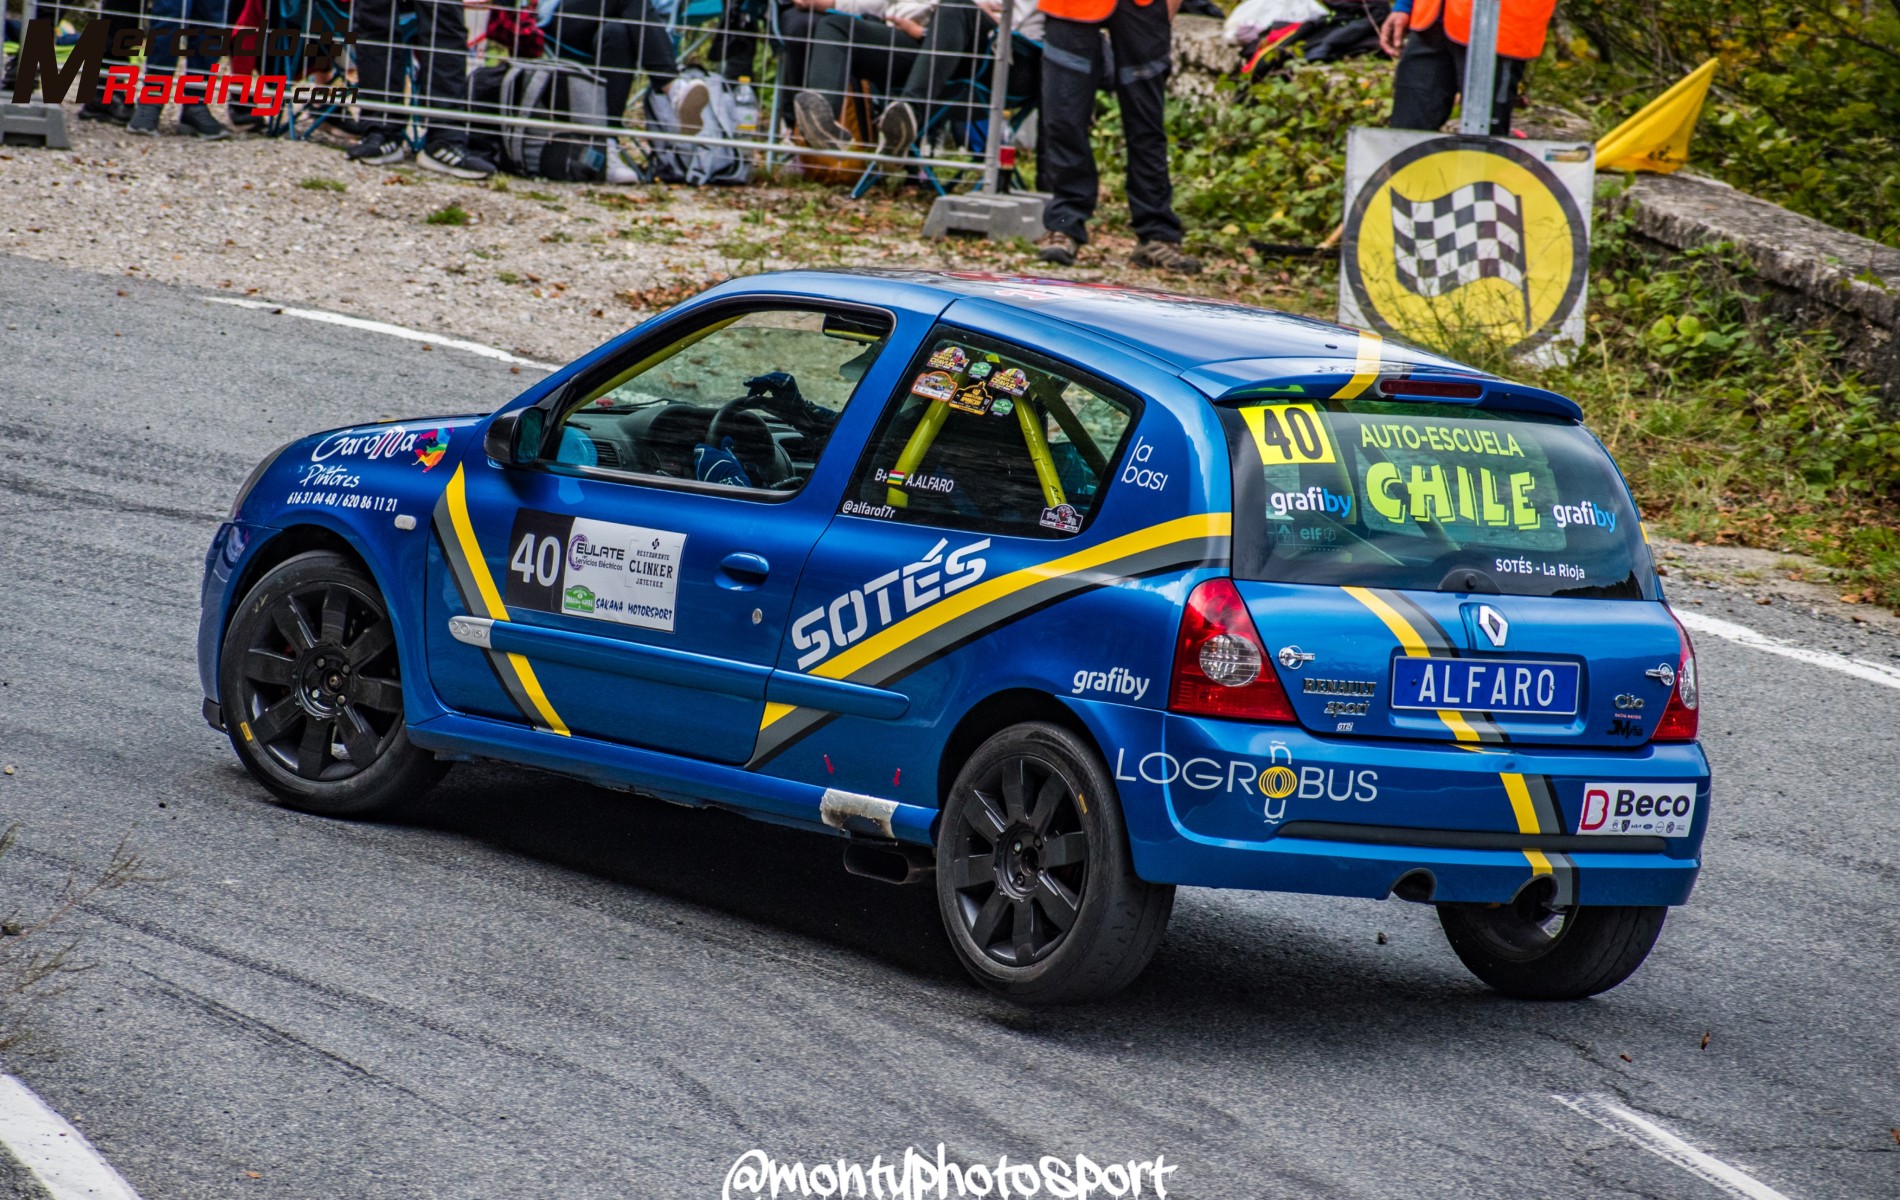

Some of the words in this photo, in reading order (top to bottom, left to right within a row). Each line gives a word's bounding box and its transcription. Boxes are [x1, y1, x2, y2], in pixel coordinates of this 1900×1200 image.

[1263, 406, 1323, 460] 40
[1360, 423, 1525, 458] AUTO-ESCUELA
[299, 464, 361, 488] Pintores
[874, 468, 888, 482] B+
[905, 474, 954, 493] A.ALFARO
[286, 491, 303, 505] 616
[301, 492, 313, 504] 31
[312, 492, 325, 505] 04
[325, 493, 337, 506] 48
[342, 494, 360, 508] 620
[360, 496, 373, 509] 86
[374, 497, 385, 511] 11
[385, 498, 398, 512] 21
[1270, 486, 1353, 518] grafiby
[1366, 461, 1540, 531] CHILE
[842, 500, 896, 519] @alfarof7r
[1553, 500, 1616, 533] grafiby
[1300, 527, 1322, 540] elf
[510, 533, 561, 587] 40
[575, 556, 598, 568] Servicios
[629, 559, 674, 579] CLINKER
[1495, 556, 1533, 574] SOTÉS
[1542, 562, 1556, 577] La
[1558, 563, 1585, 580] Rioja
[595, 598, 624, 612] SAKANA
[627, 603, 673, 620] MOTORSPORT
[791, 537, 991, 671] SOTÉS
[1071, 666, 1150, 701] grafiby
[1303, 677, 1377, 697] RENAULT
[1418, 663, 1556, 707] ALFARO
[1323, 700, 1371, 717] sport
[1614, 692, 1646, 709] Clio
[1613, 789, 1691, 818] Beco
